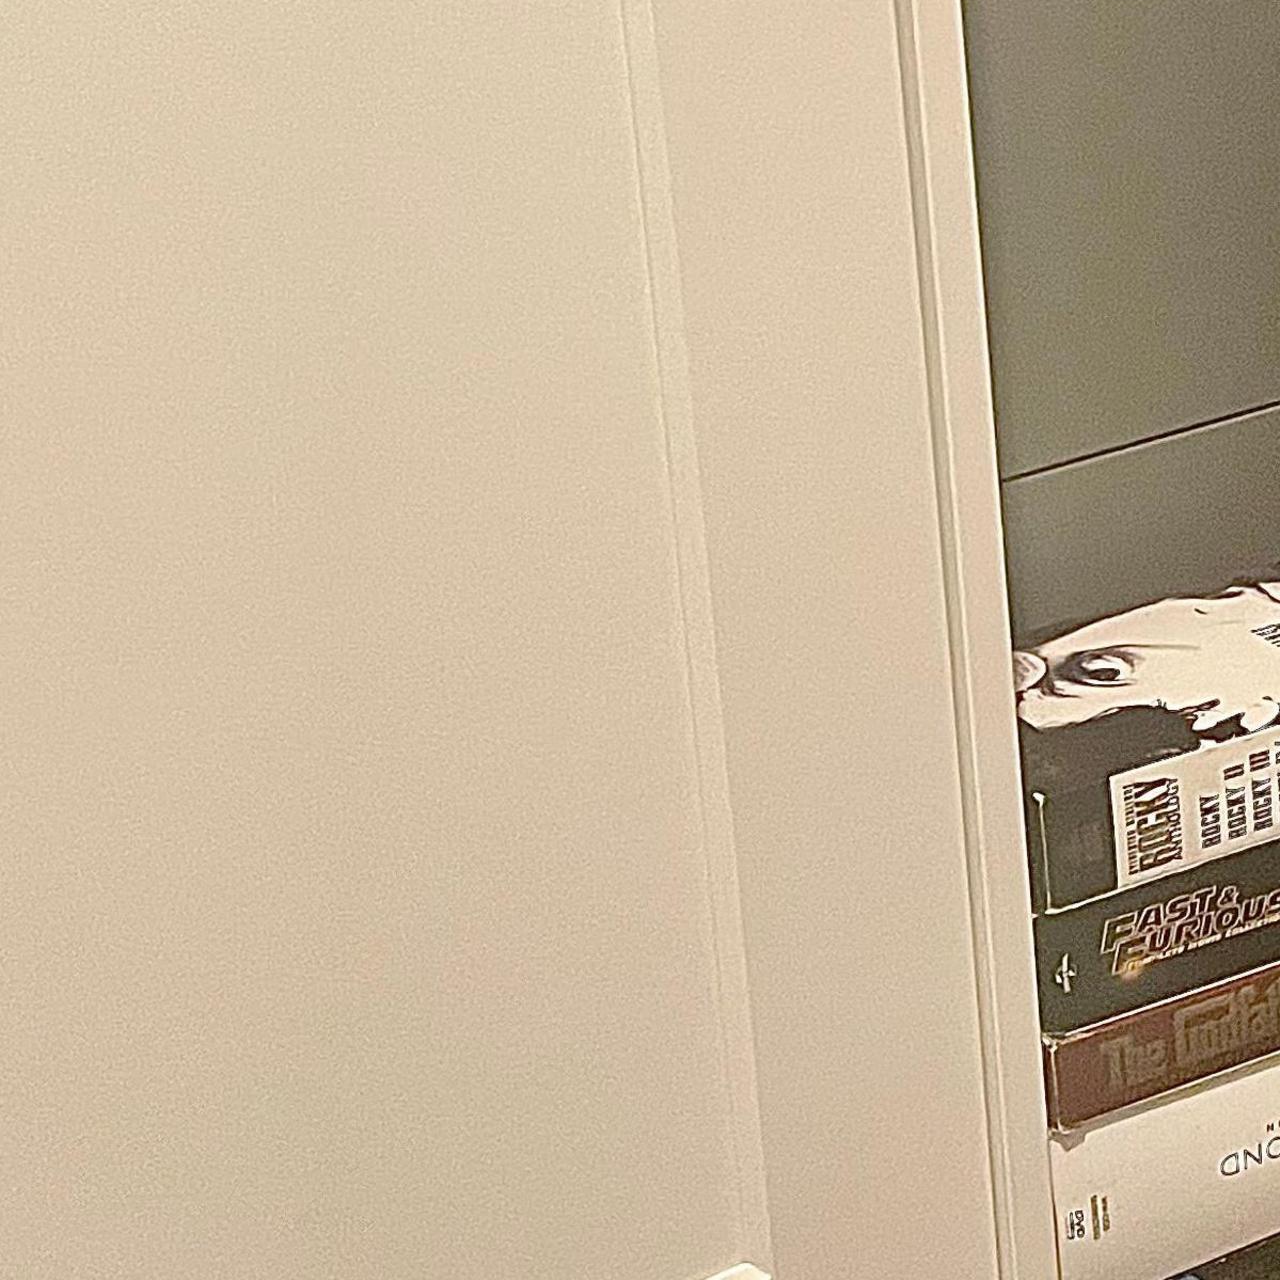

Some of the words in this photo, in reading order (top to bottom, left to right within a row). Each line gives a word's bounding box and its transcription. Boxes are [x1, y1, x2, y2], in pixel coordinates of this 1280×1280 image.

[1223, 763, 1245, 781] II
[1249, 749, 1271, 772] III
[1133, 777, 1177, 871] ROCKY
[1199, 793, 1222, 849] ROCKY
[1225, 785, 1247, 840] ROCKY
[1251, 777, 1273, 832] ROCKY
[1100, 885, 1217, 954] FAST
[1217, 884, 1239, 907] &
[1101, 1035, 1170, 1090] The
